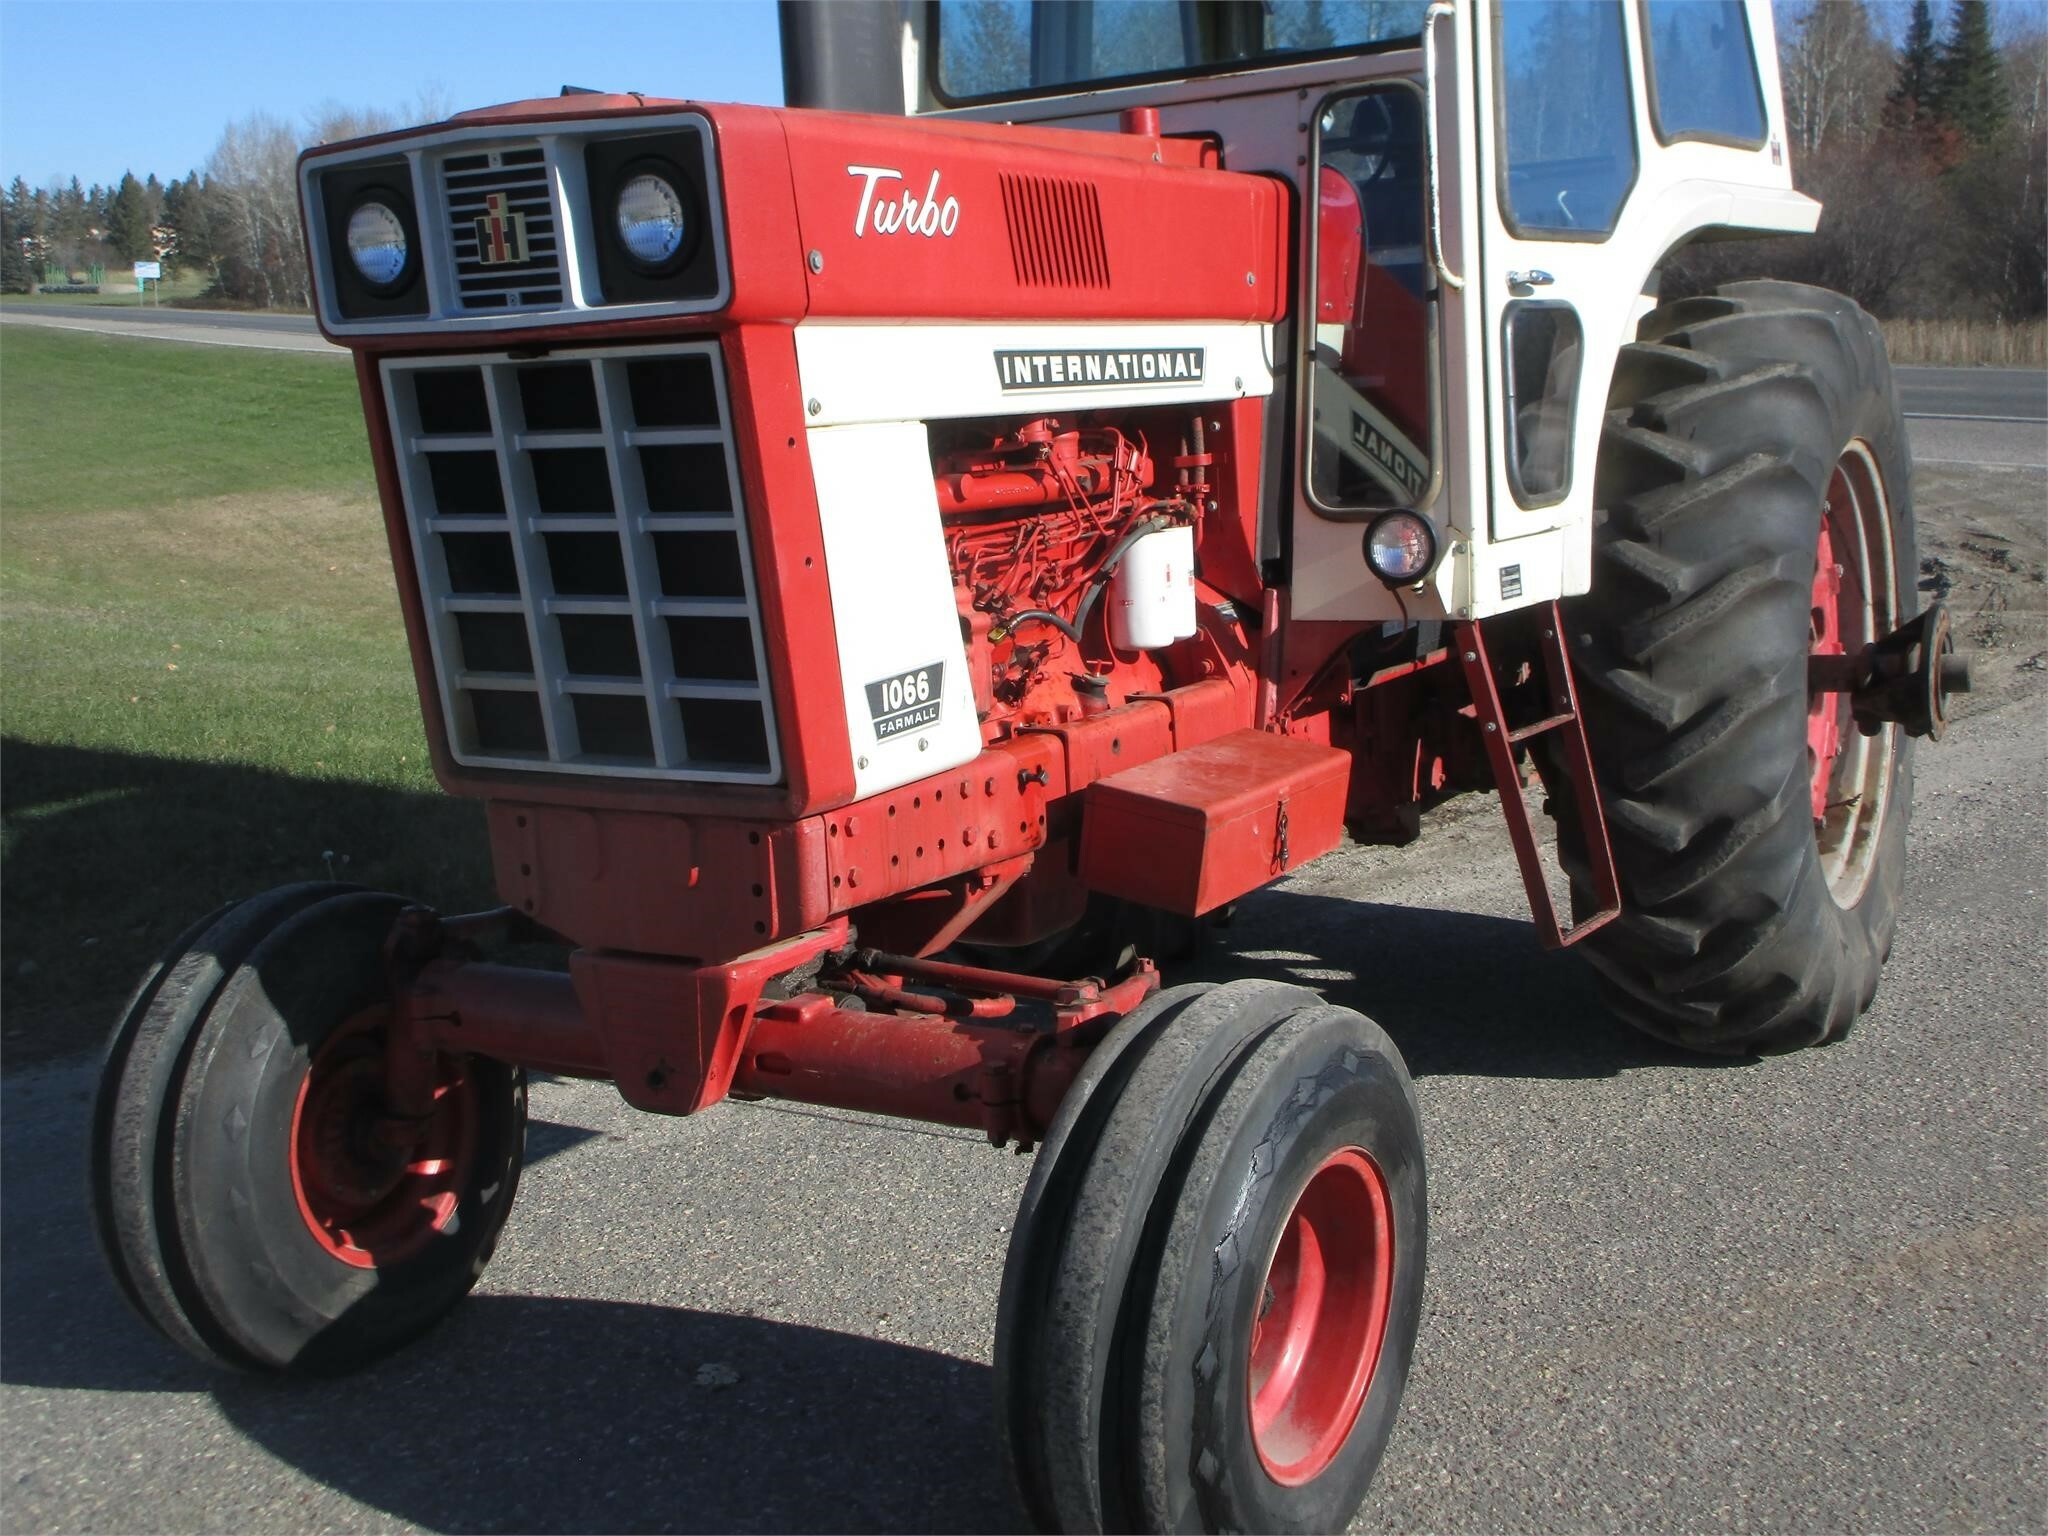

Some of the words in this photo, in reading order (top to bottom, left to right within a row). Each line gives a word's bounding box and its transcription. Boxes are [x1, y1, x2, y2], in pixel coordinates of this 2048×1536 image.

[847, 165, 959, 237] Turbo
[1002, 353, 1201, 384] INTERNATIONAL
[881, 670, 930, 713] 1066
[879, 707, 937, 735] FARMALL
